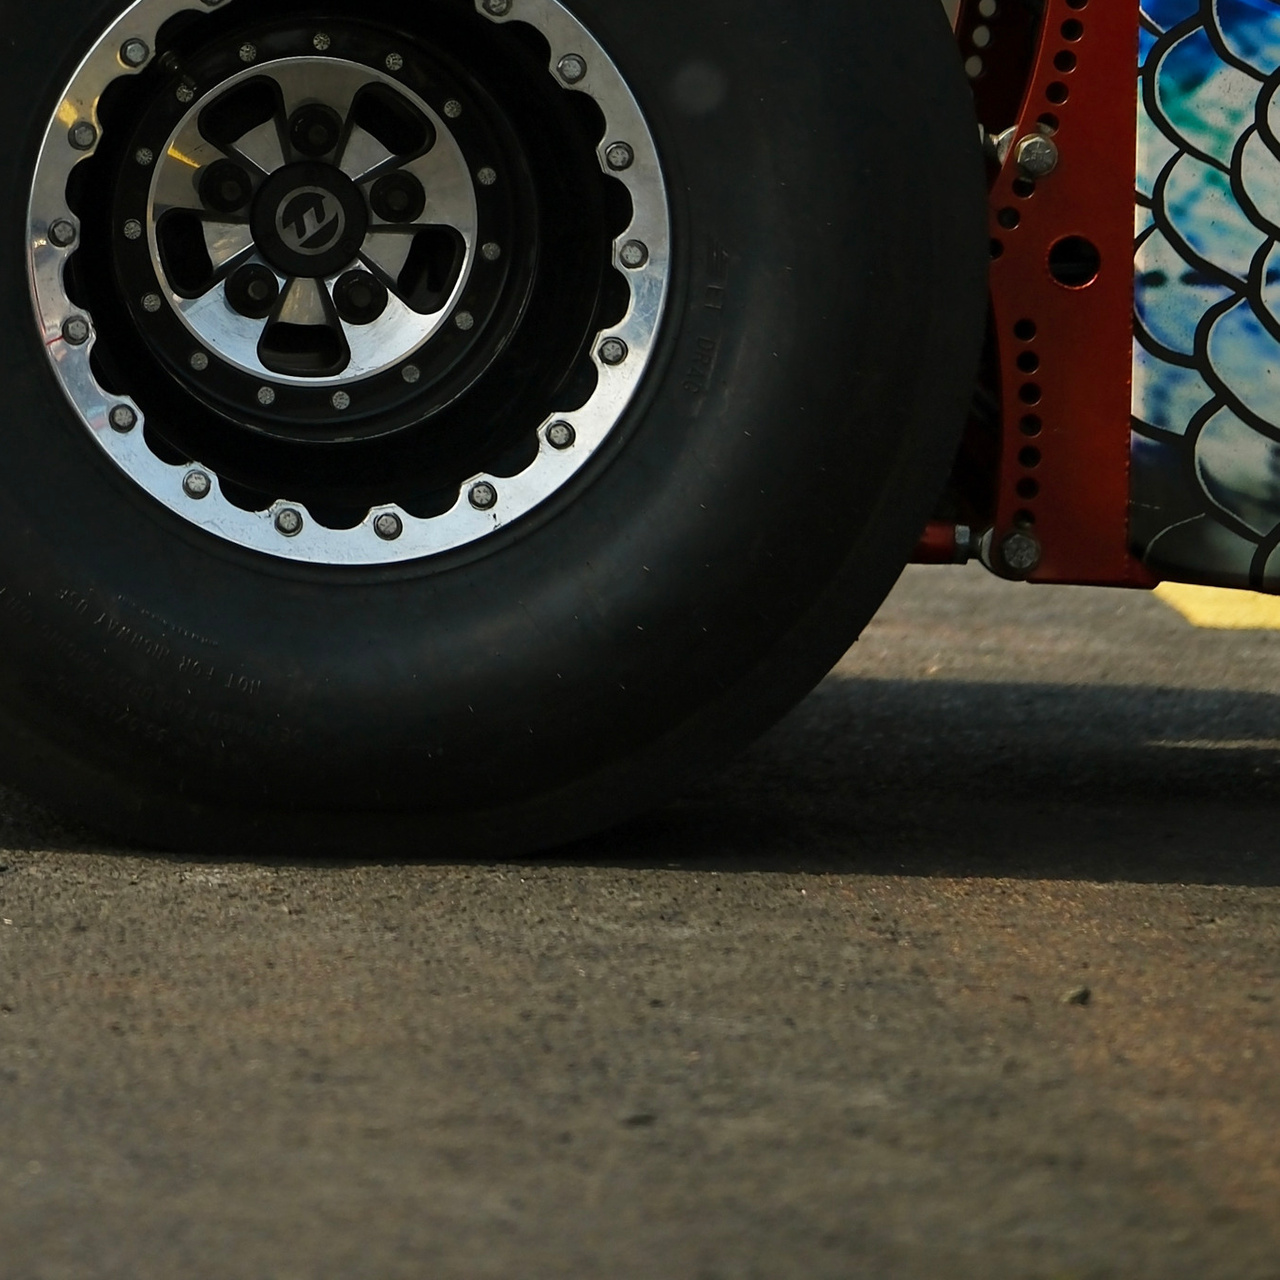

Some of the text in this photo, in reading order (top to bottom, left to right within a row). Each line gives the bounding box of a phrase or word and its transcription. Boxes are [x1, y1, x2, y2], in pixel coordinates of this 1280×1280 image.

[680, 336, 716, 395] DRAG
[93, 611, 170, 662] HIGHWAY
[177, 656, 213, 681] FOR
[225, 672, 260, 694] NOT
